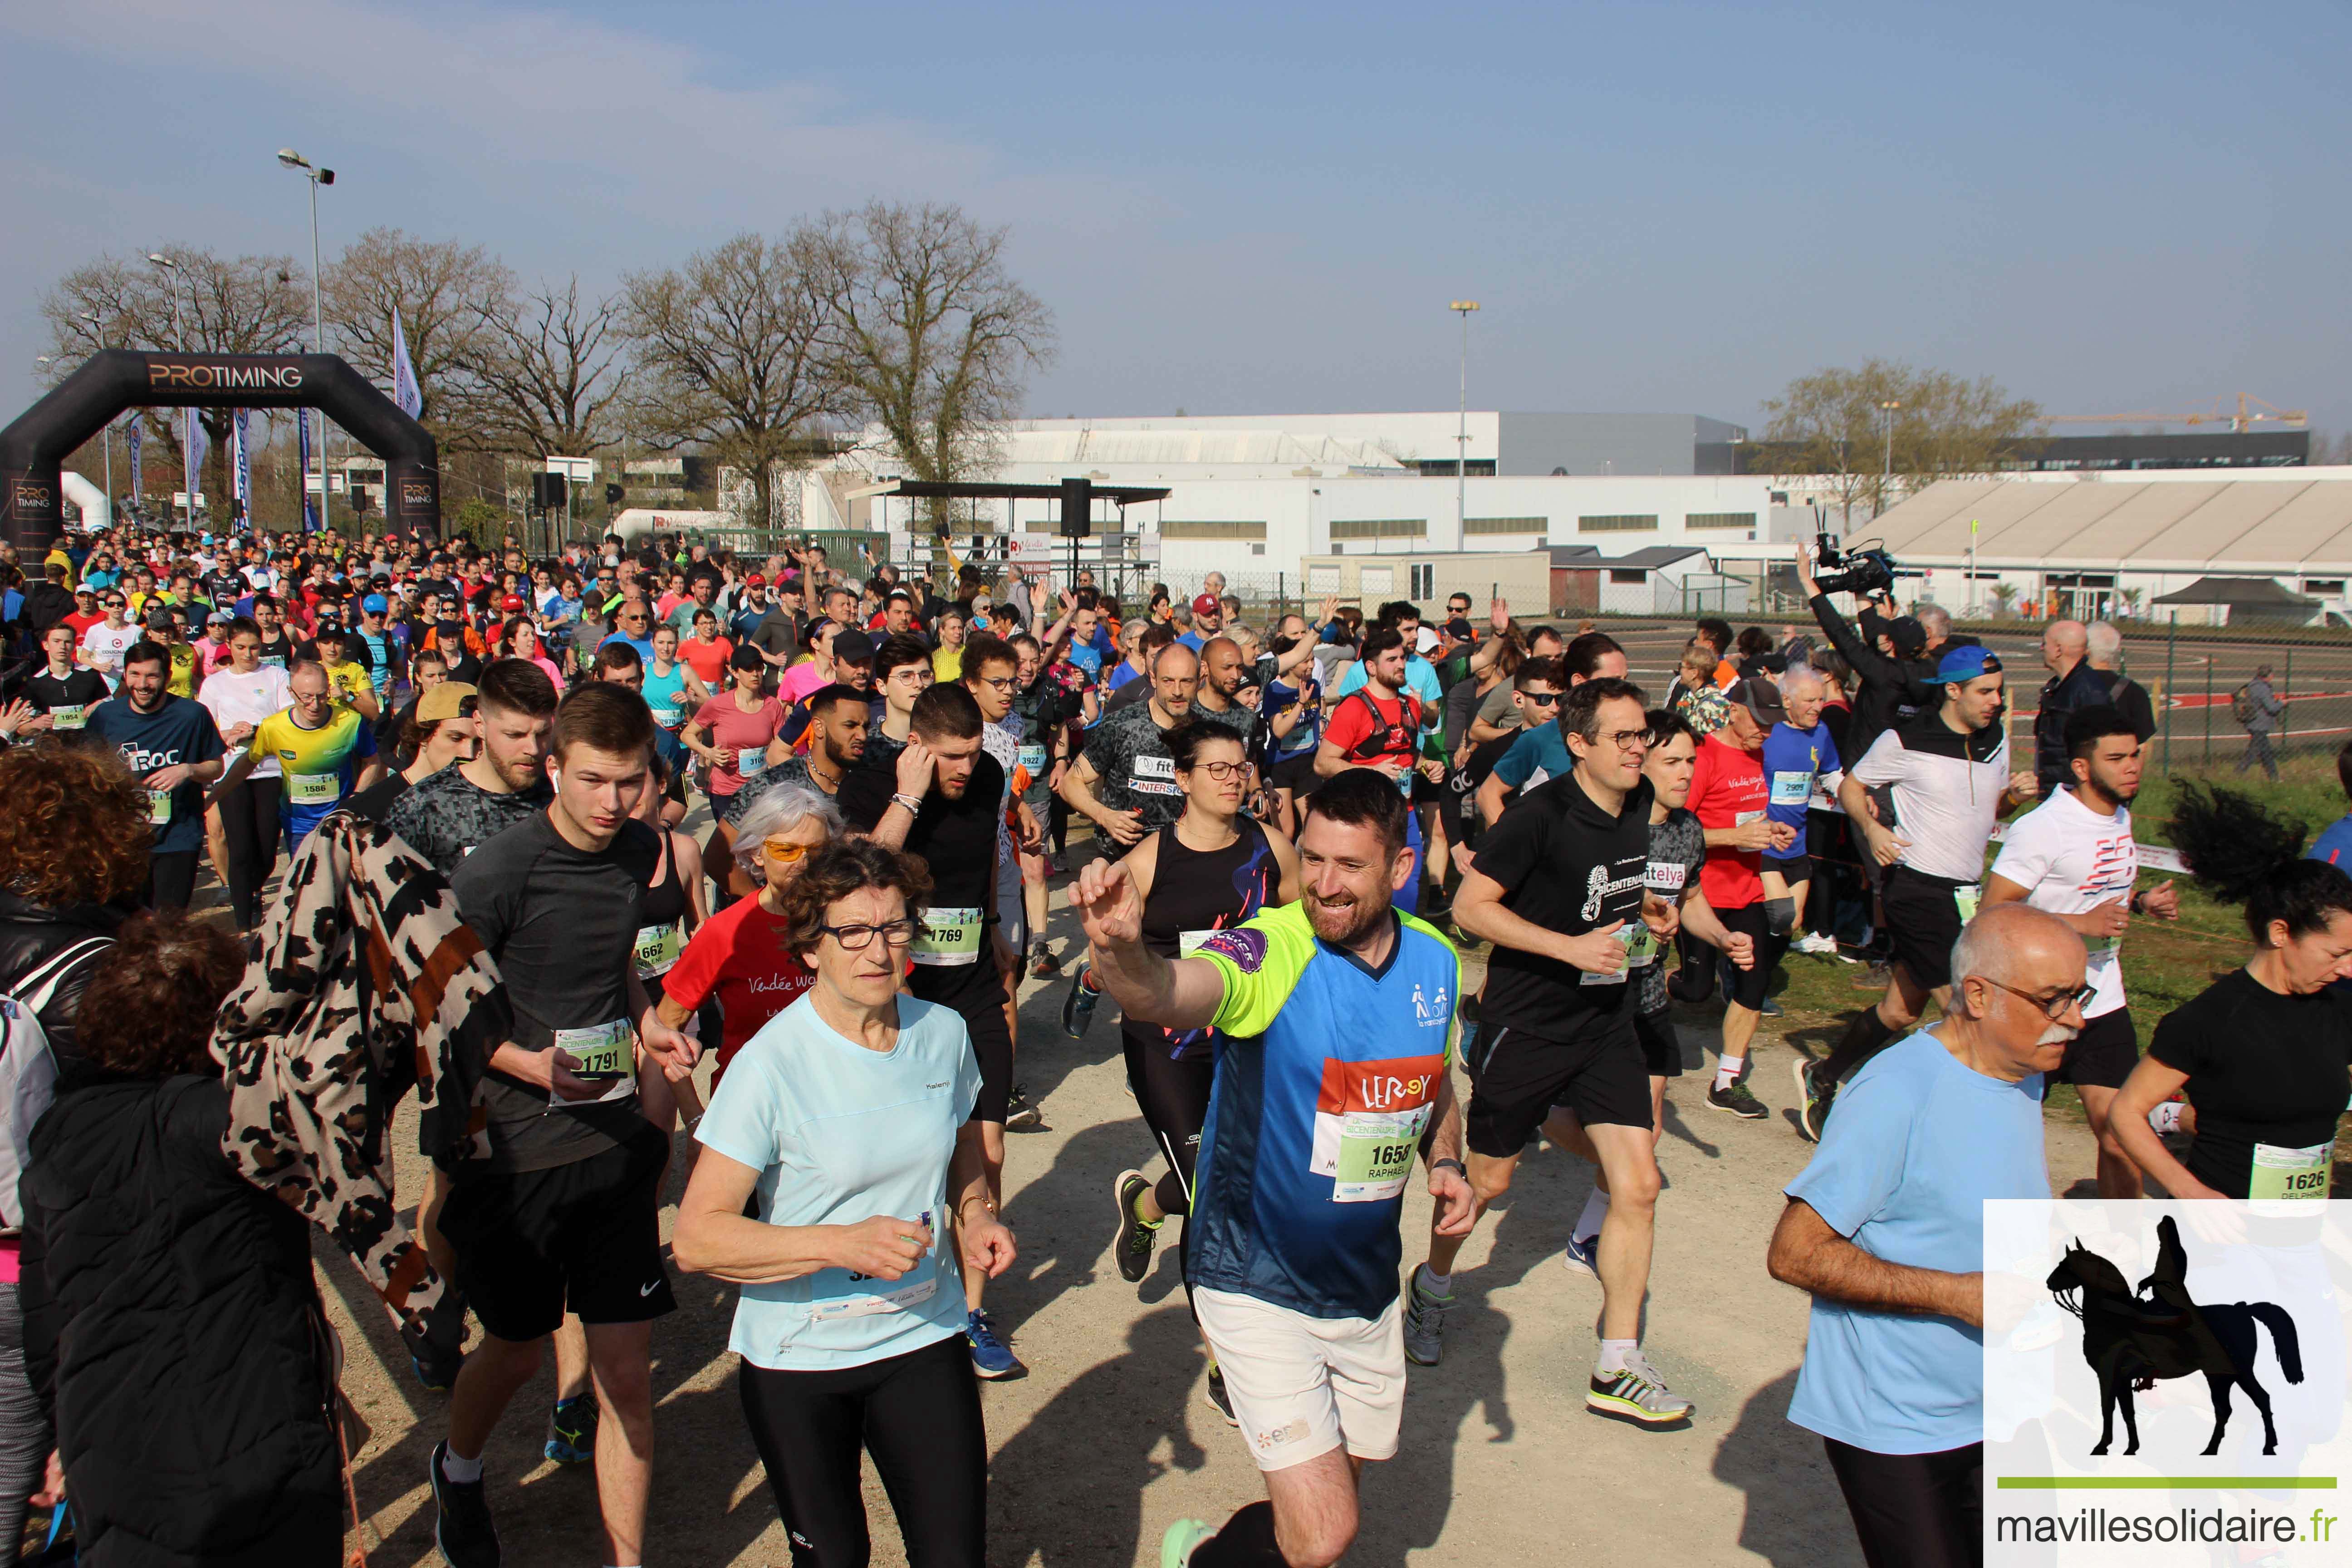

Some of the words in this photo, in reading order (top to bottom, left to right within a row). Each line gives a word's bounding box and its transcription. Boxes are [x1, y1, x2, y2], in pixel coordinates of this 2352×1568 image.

[149, 364, 303, 387] PROTIMING
[16, 487, 49, 499] PRO
[403, 484, 431, 495] PRO
[17, 499, 50, 507] TIMING
[404, 495, 432, 504] TIMING
[931, 929, 962, 942] 1769
[749, 972, 794, 994] Vendée
[583, 1049, 618, 1072] 1791
[926, 1080, 951, 1089] Kalenji
[1362, 1074, 1431, 1108] LEROY
[1346, 1126, 1397, 1135] BICENTENAIRE
[1372, 1143, 1412, 1165] 1658
[1368, 1168, 1405, 1178] RAPHAEL
[2286, 1170, 2325, 1190] 1626
[2282, 1188, 2323, 1199] DELPHINE
